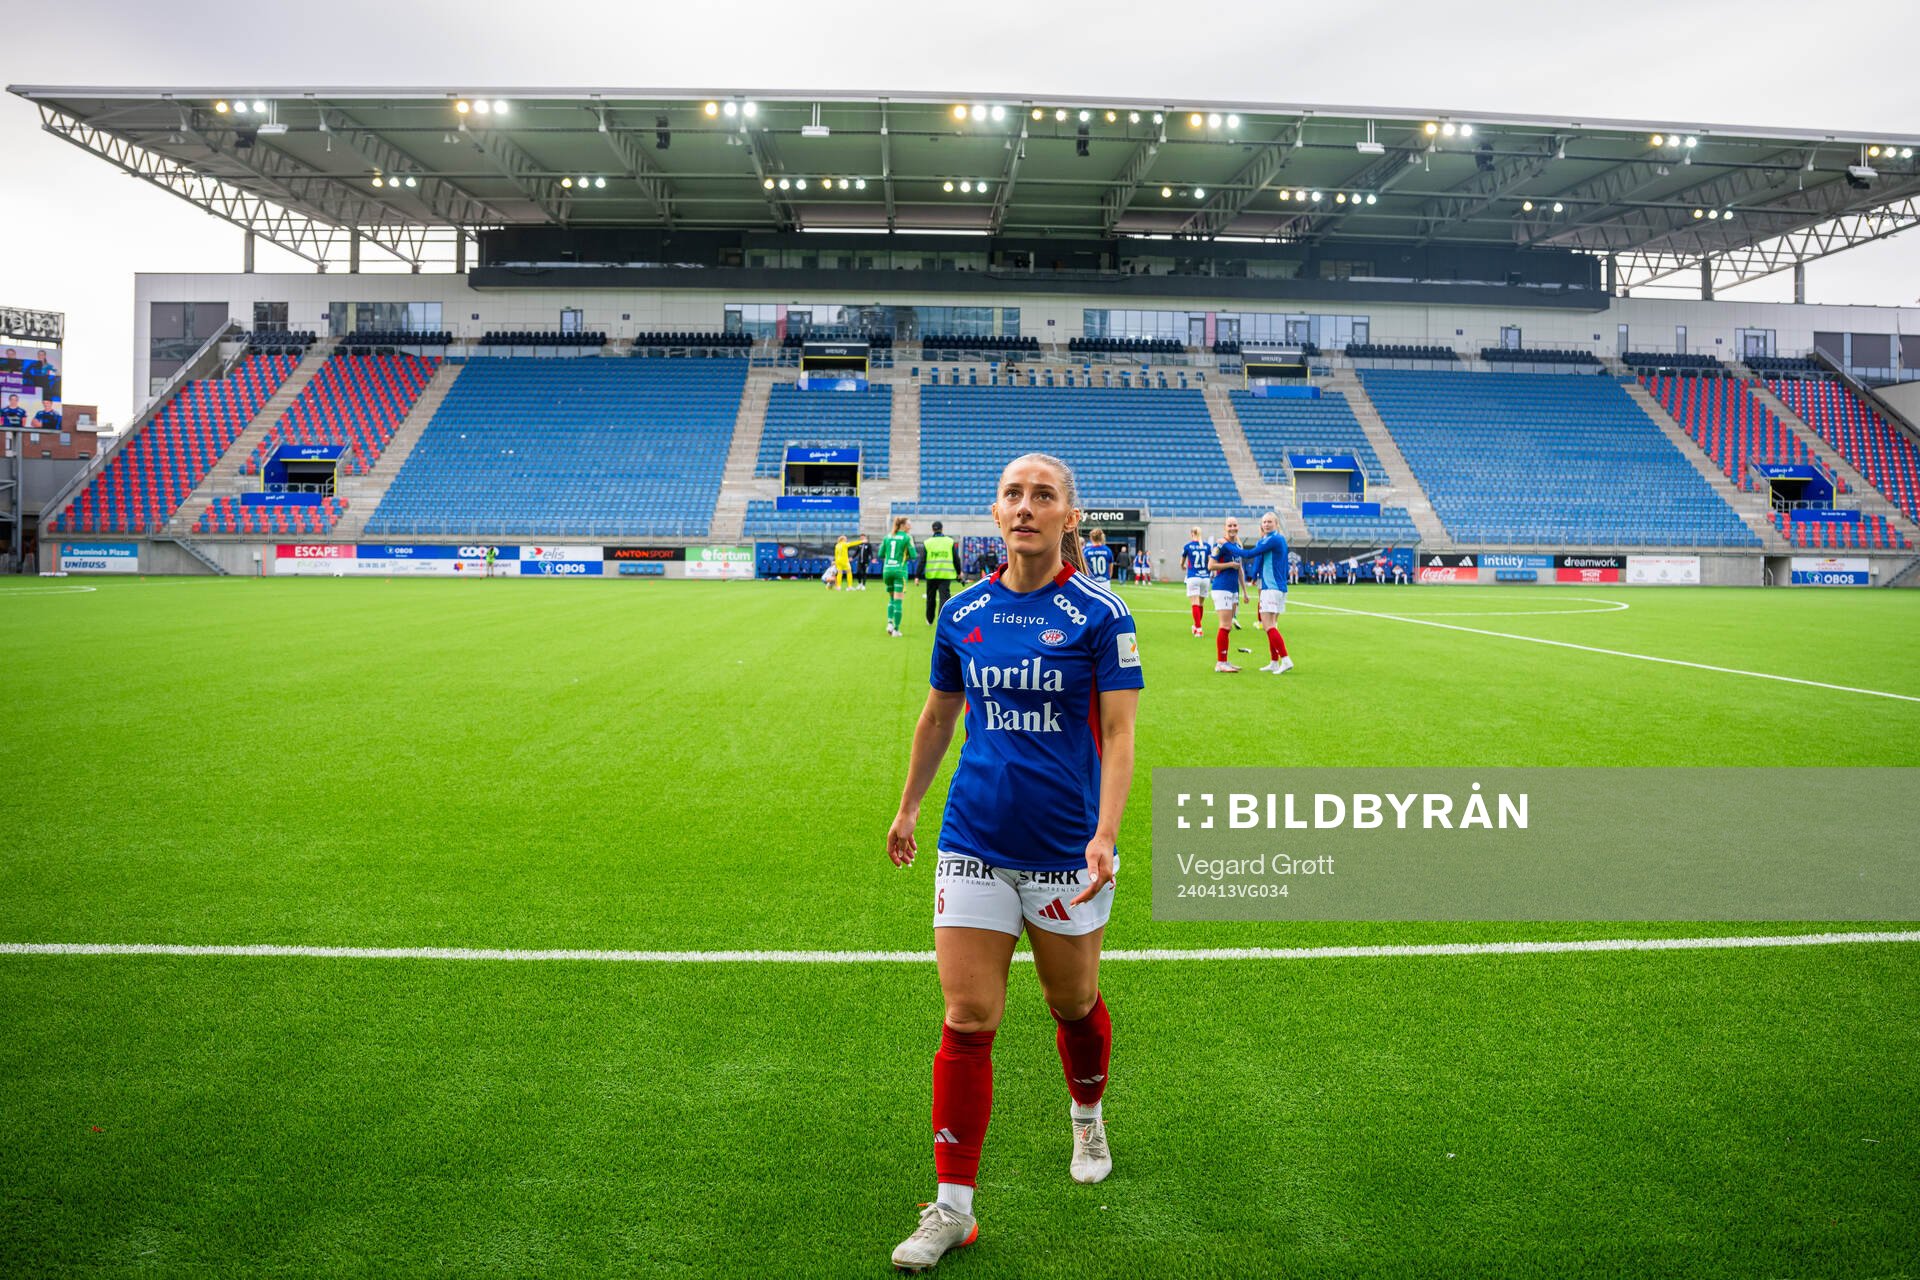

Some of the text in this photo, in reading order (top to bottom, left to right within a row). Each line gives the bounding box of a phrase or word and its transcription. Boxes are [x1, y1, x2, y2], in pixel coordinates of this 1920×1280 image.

[1090, 512, 1124, 520] arena
[295, 546, 338, 557] ESCAPE
[542, 546, 565, 560] elis
[713, 549, 751, 561] fortum
[890, 541, 896, 558] 1
[555, 563, 586, 573] OBOS
[1091, 556, 1106, 575] 10
[1192, 551, 1206, 568] 21
[1484, 555, 1523, 568] intility
[1824, 574, 1855, 584] OBOS
[952, 593, 991, 622] coop
[1053, 593, 1087, 625] coop
[965, 656, 1065, 697] Aprila
[983, 700, 1063, 733] Bank
[937, 888, 945, 914] 6
